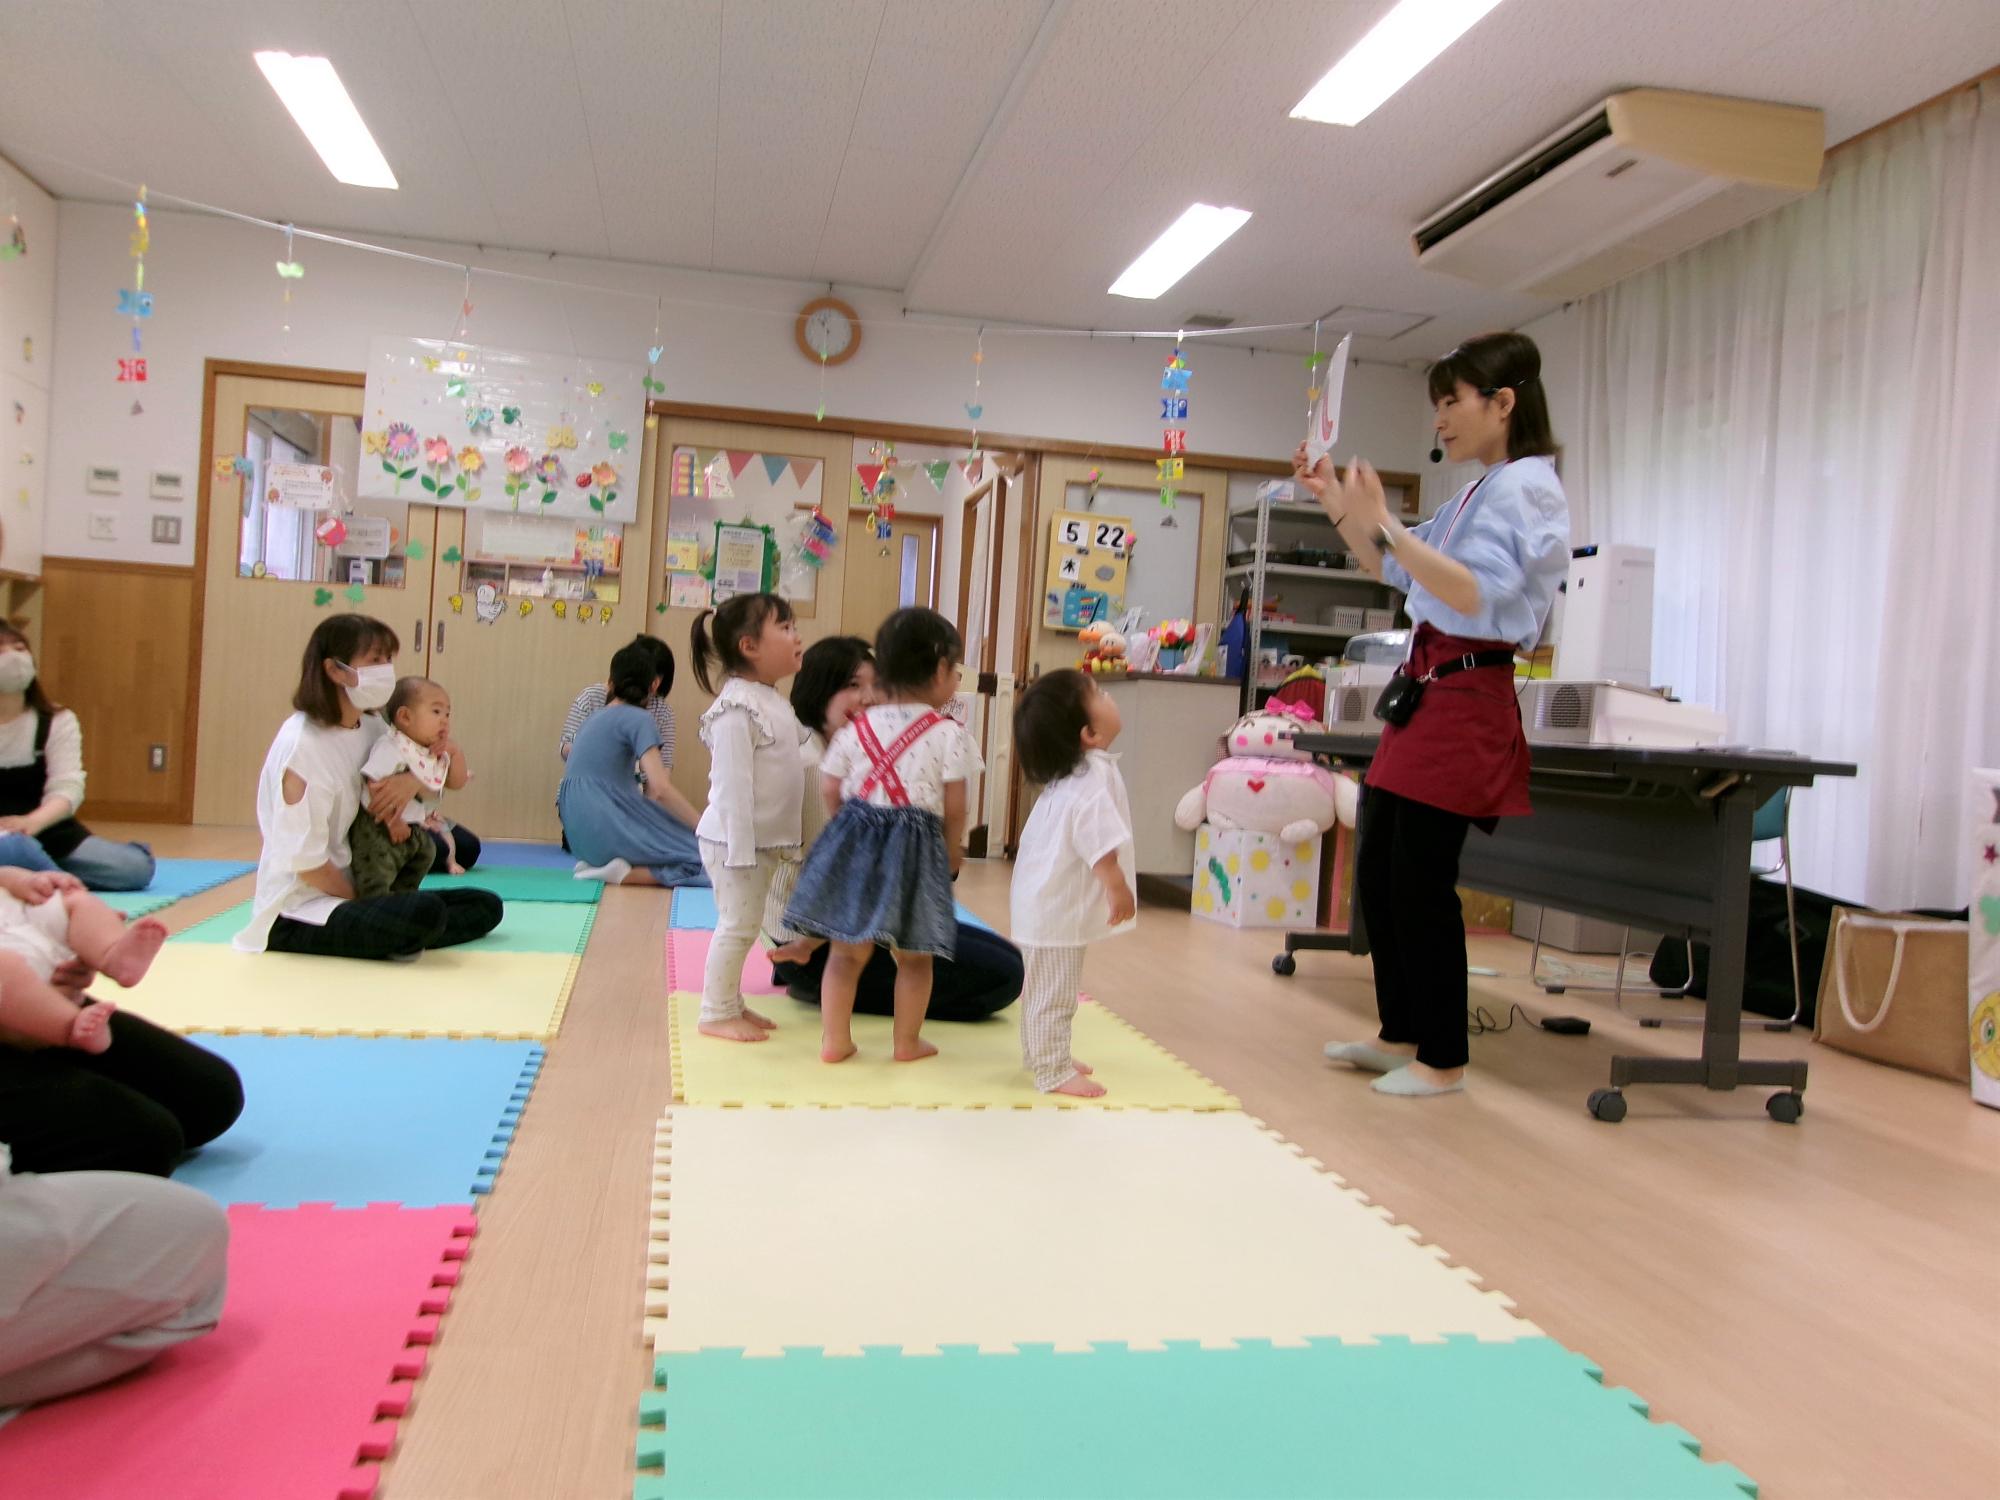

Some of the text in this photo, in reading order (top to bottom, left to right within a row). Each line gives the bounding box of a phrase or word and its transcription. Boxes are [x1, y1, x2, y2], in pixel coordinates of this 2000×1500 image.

[1066, 521, 1124, 548] 5 22
[1063, 558, 1076, 573] 木
